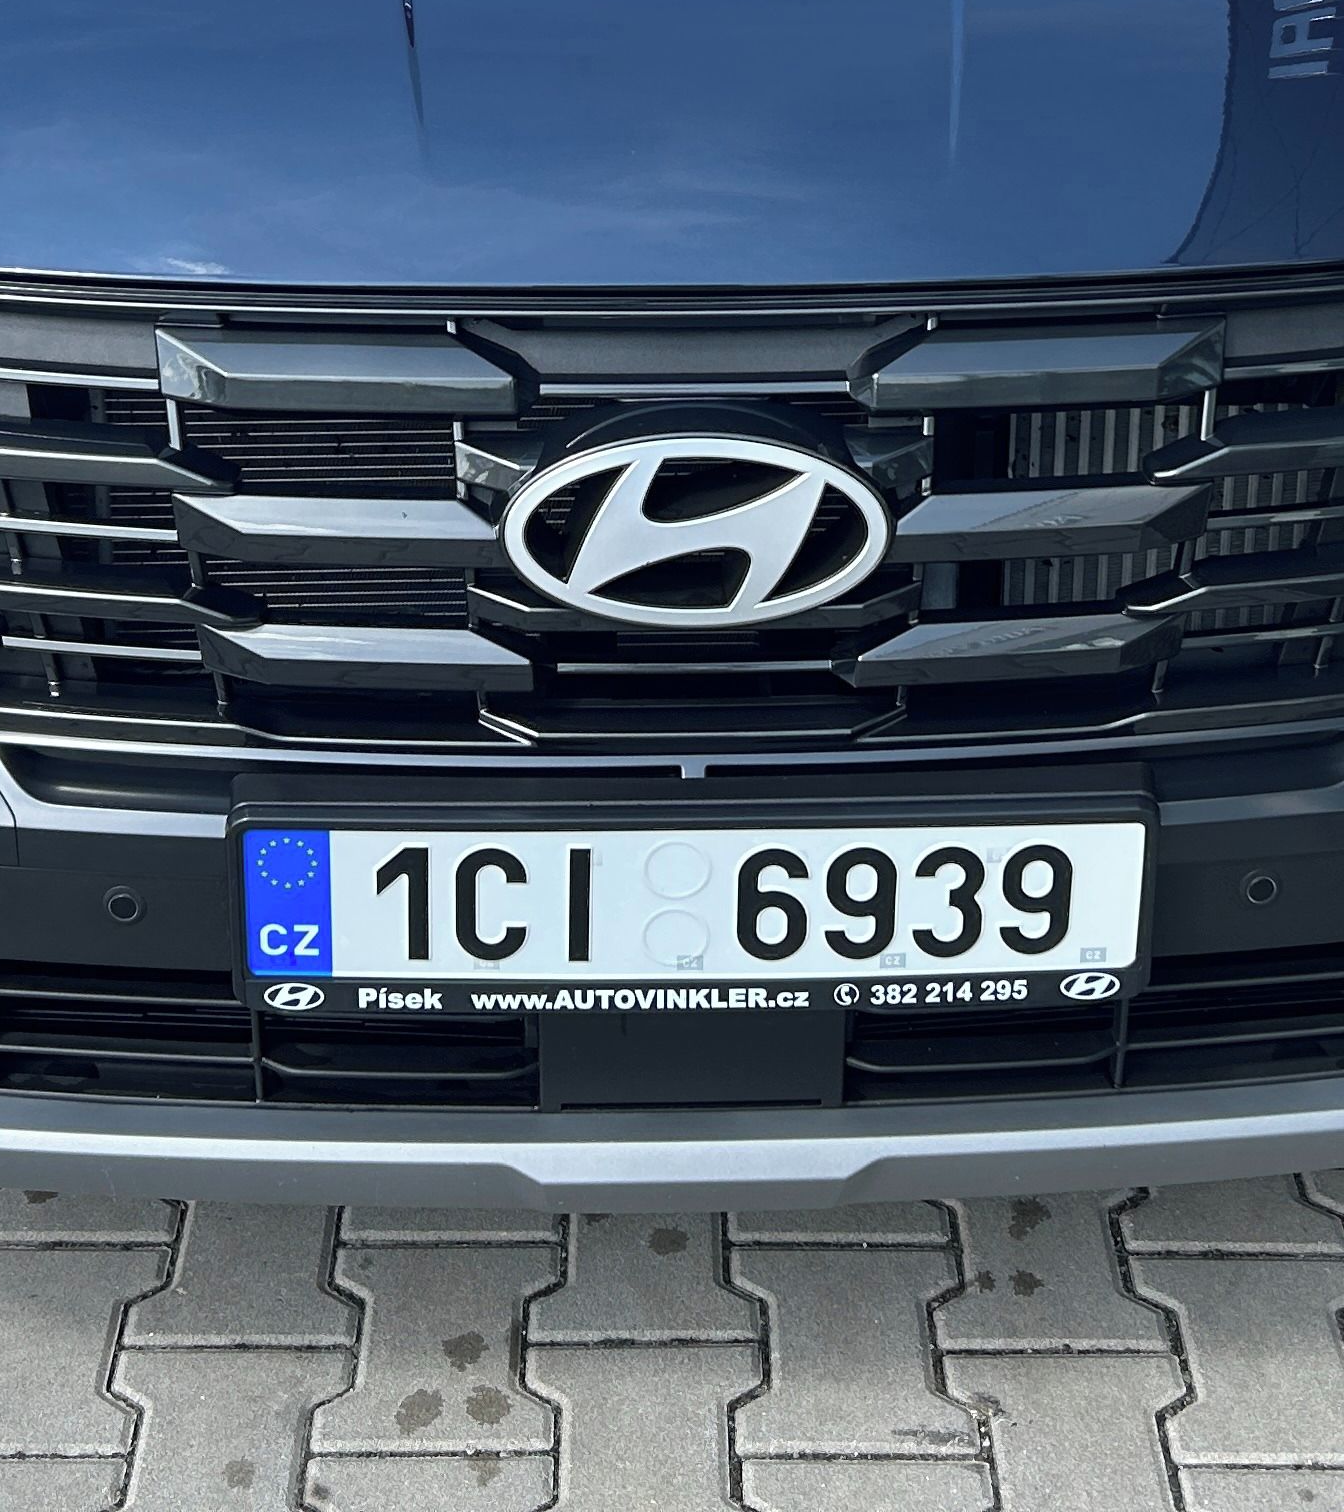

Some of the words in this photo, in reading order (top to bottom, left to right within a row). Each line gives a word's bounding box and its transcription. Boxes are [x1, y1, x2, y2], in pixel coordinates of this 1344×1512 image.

[376, 847, 591, 962] 1CI
[737, 844, 1073, 961] 6939
[259, 923, 320, 956] CZ
[358, 987, 443, 1010] Písek
[471, 987, 810, 1010] www.AUTOVINKLER.cz
[870, 984, 917, 1005] 382
[925, 982, 973, 1003] 214
[979, 979, 1028, 1001] 295
